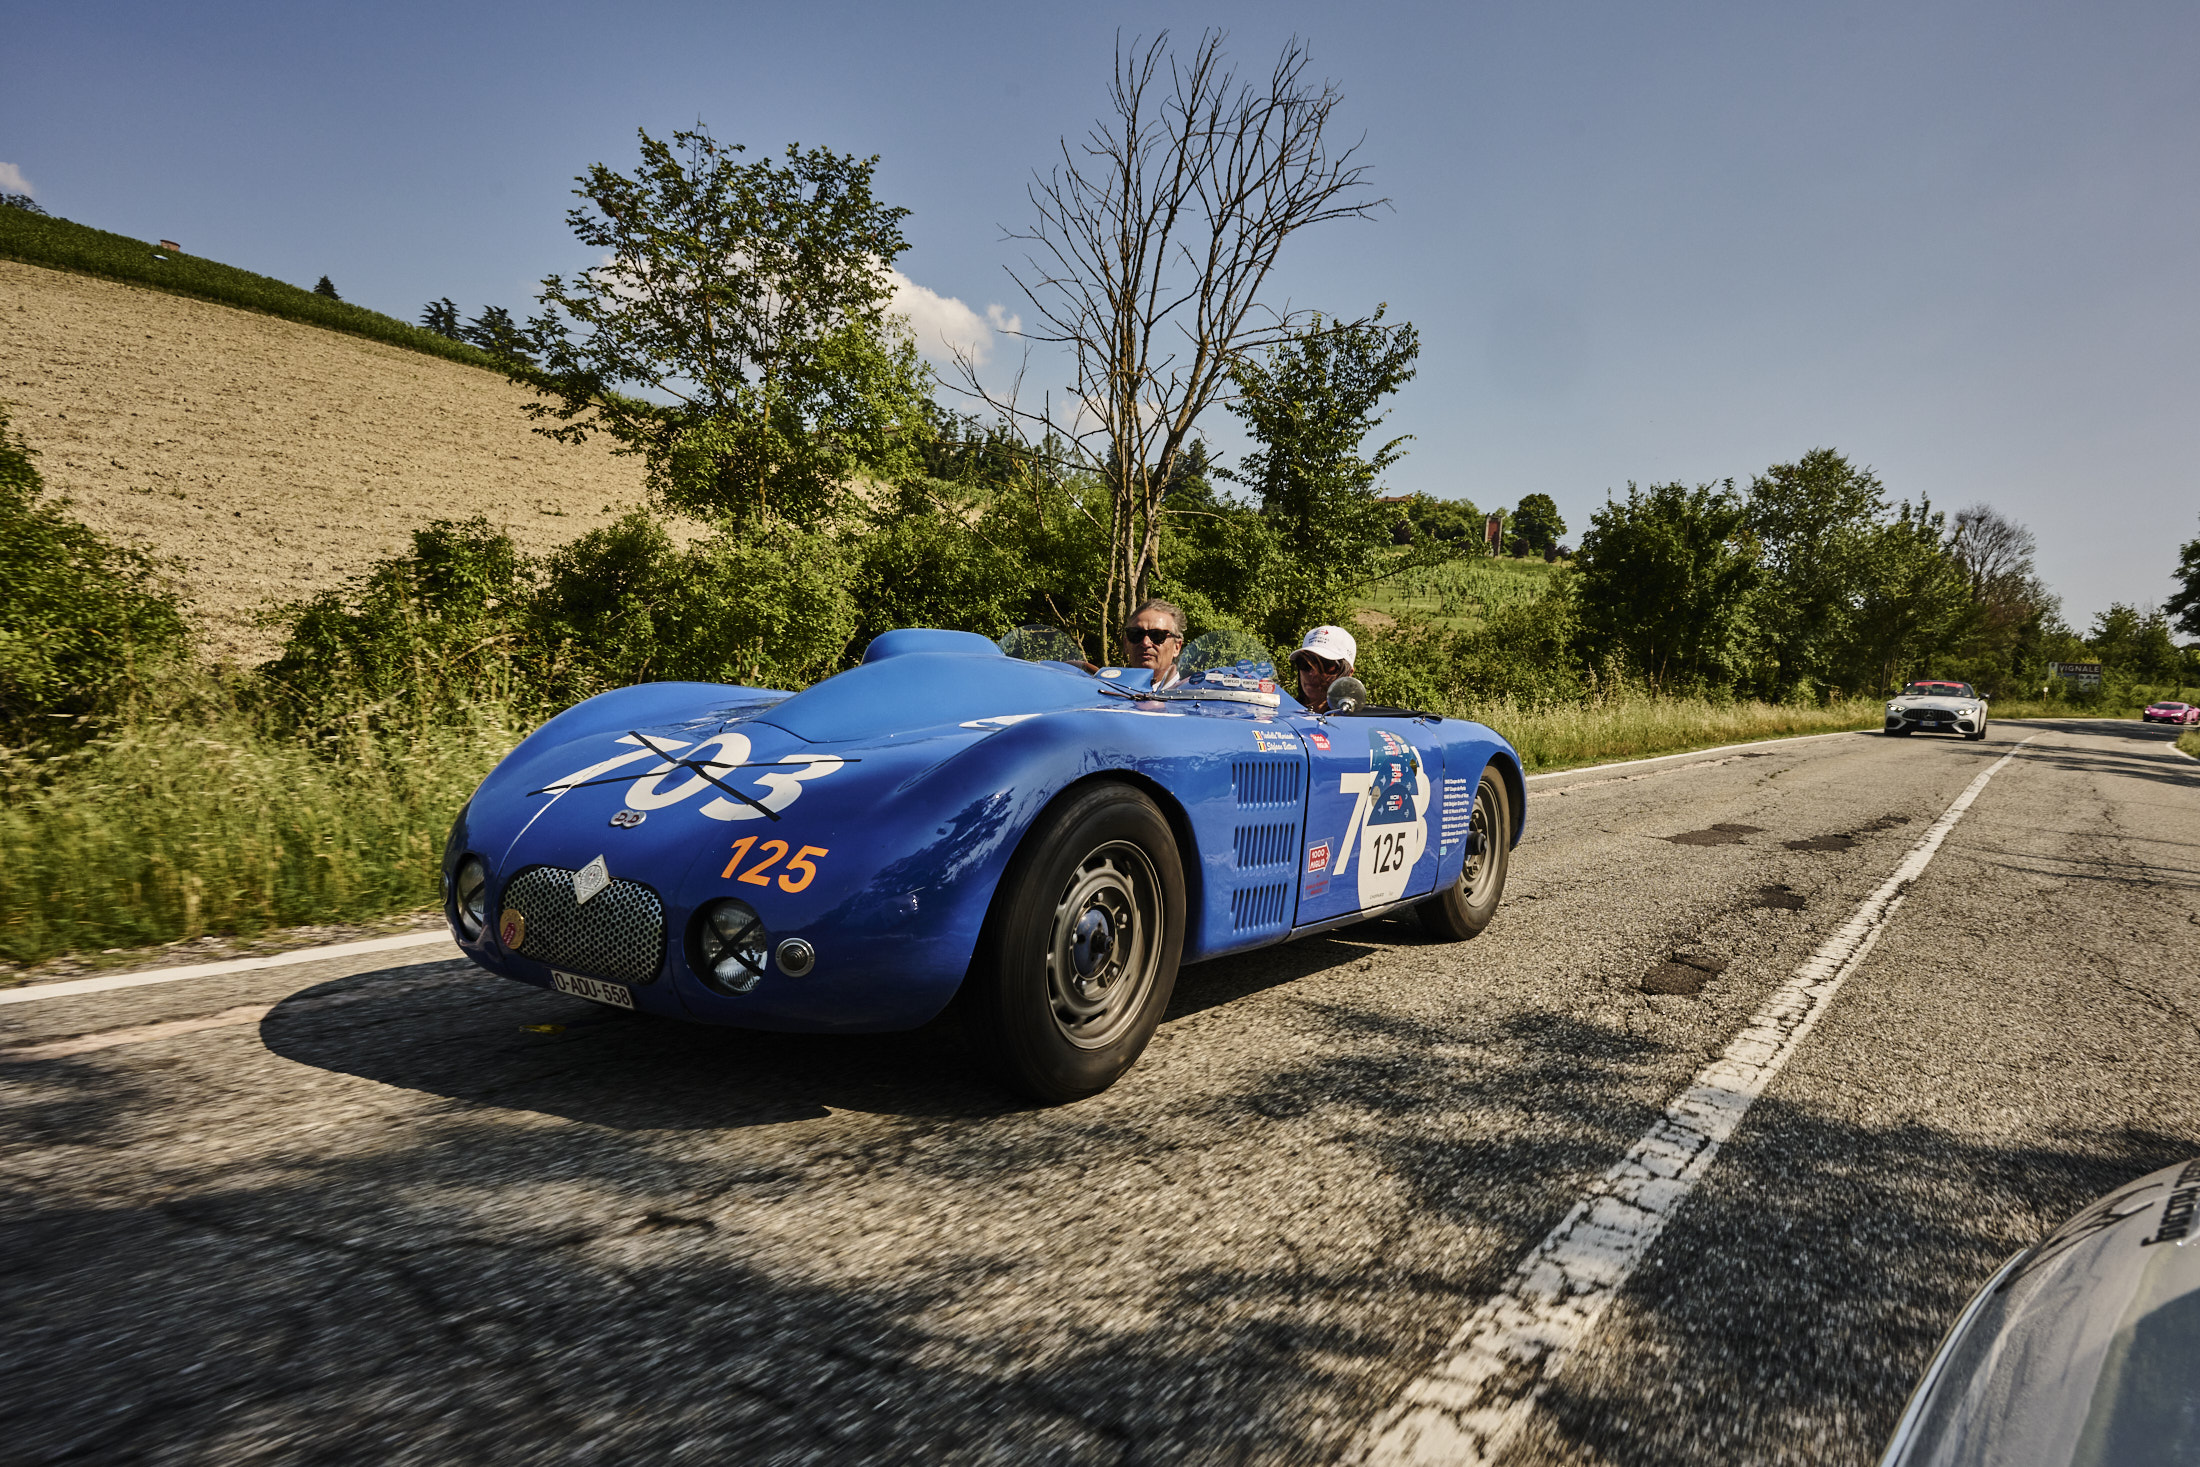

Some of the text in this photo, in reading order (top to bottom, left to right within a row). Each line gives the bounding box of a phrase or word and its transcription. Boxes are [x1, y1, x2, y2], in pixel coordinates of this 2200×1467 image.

[2059, 664, 2100, 673] VIGNALE
[542, 732, 845, 821] 703
[721, 835, 829, 893] 125
[1310, 858, 1326, 870] MIGLIA
[1311, 848, 1326, 859] 1000
[1372, 831, 1406, 875] 125
[554, 971, 631, 1007] O-ADU-558
